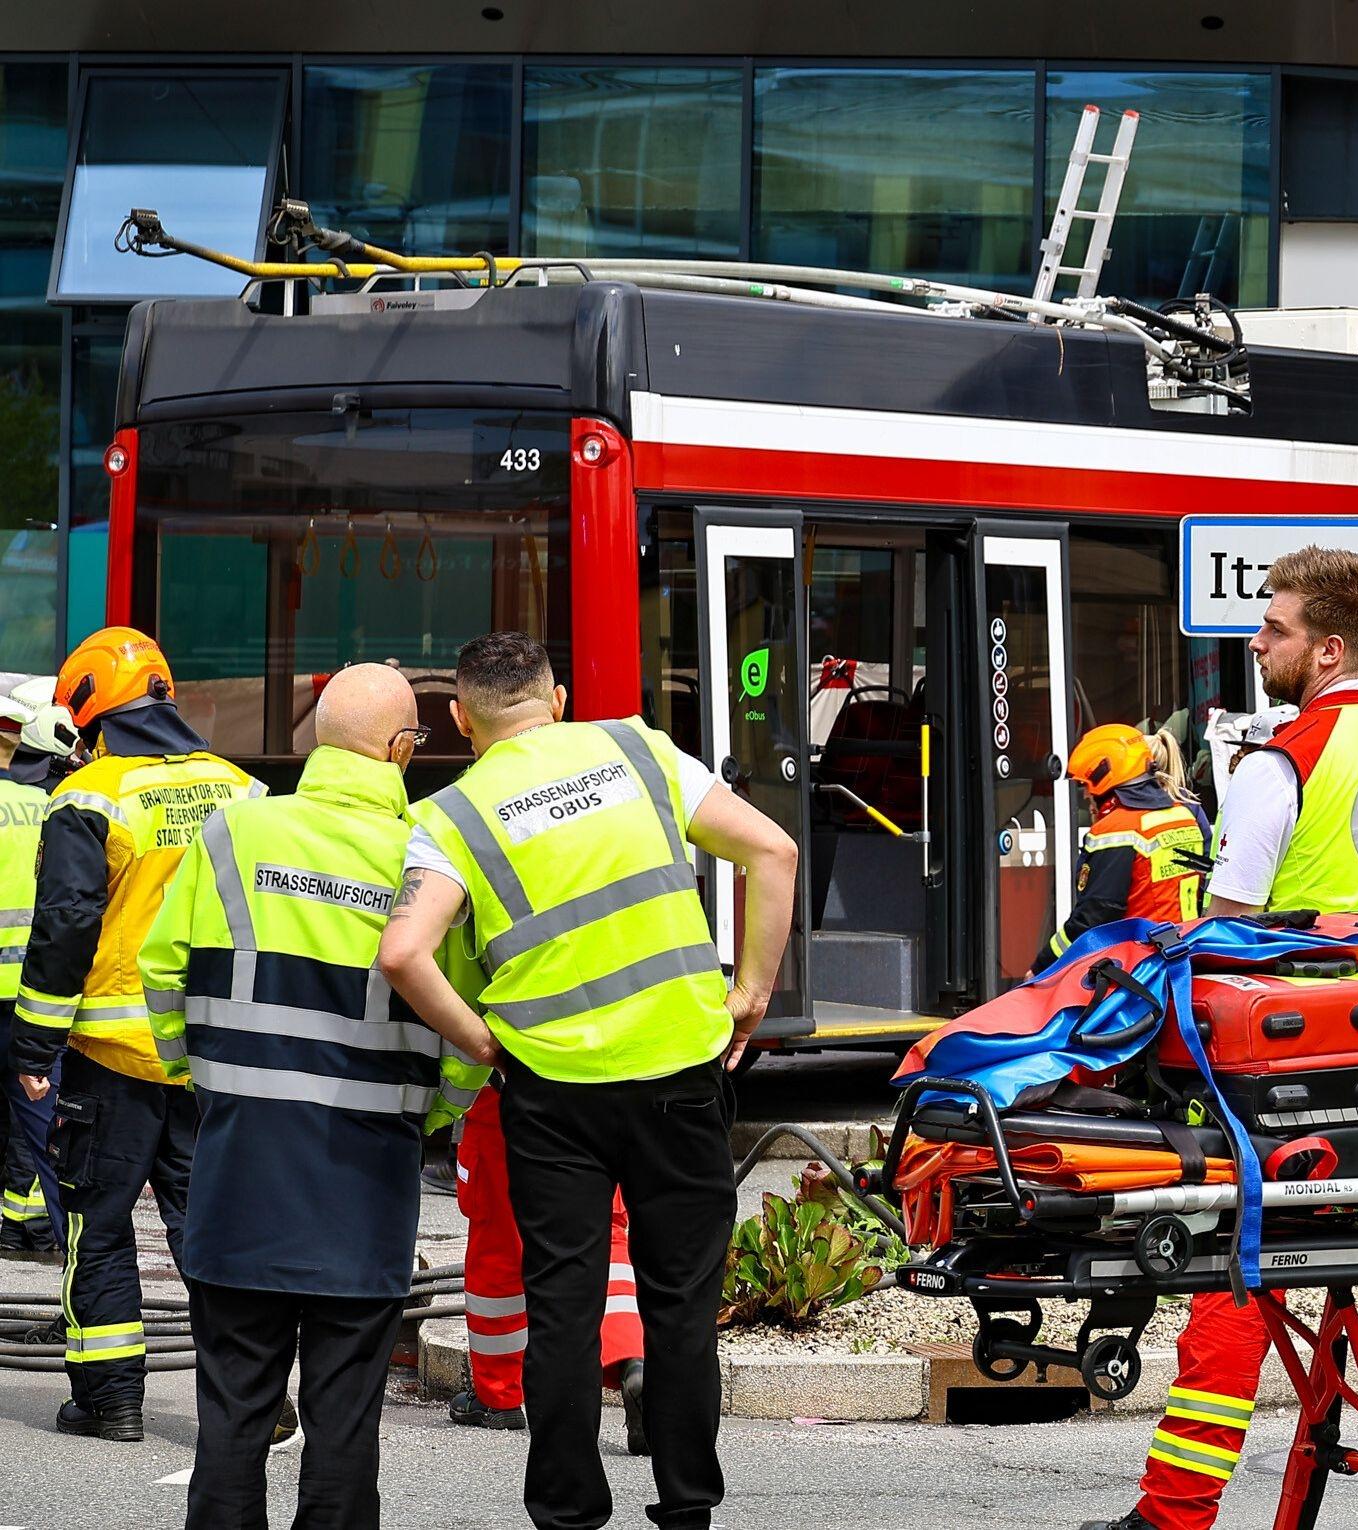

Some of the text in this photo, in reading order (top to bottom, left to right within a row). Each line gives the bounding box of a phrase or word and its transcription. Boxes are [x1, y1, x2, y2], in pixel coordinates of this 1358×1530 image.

[500, 448, 541, 471] 433
[745, 711, 766, 721] eObus
[498, 764, 628, 821] STRASSENAUFSICHT
[550, 792, 602, 820] OBUS
[256, 869, 392, 910] STRASSENAUFSICHT
[1284, 1182, 1341, 1196] MONDIAL
[1271, 1253, 1308, 1266] FERNO
[916, 1272, 946, 1290] FERNO
